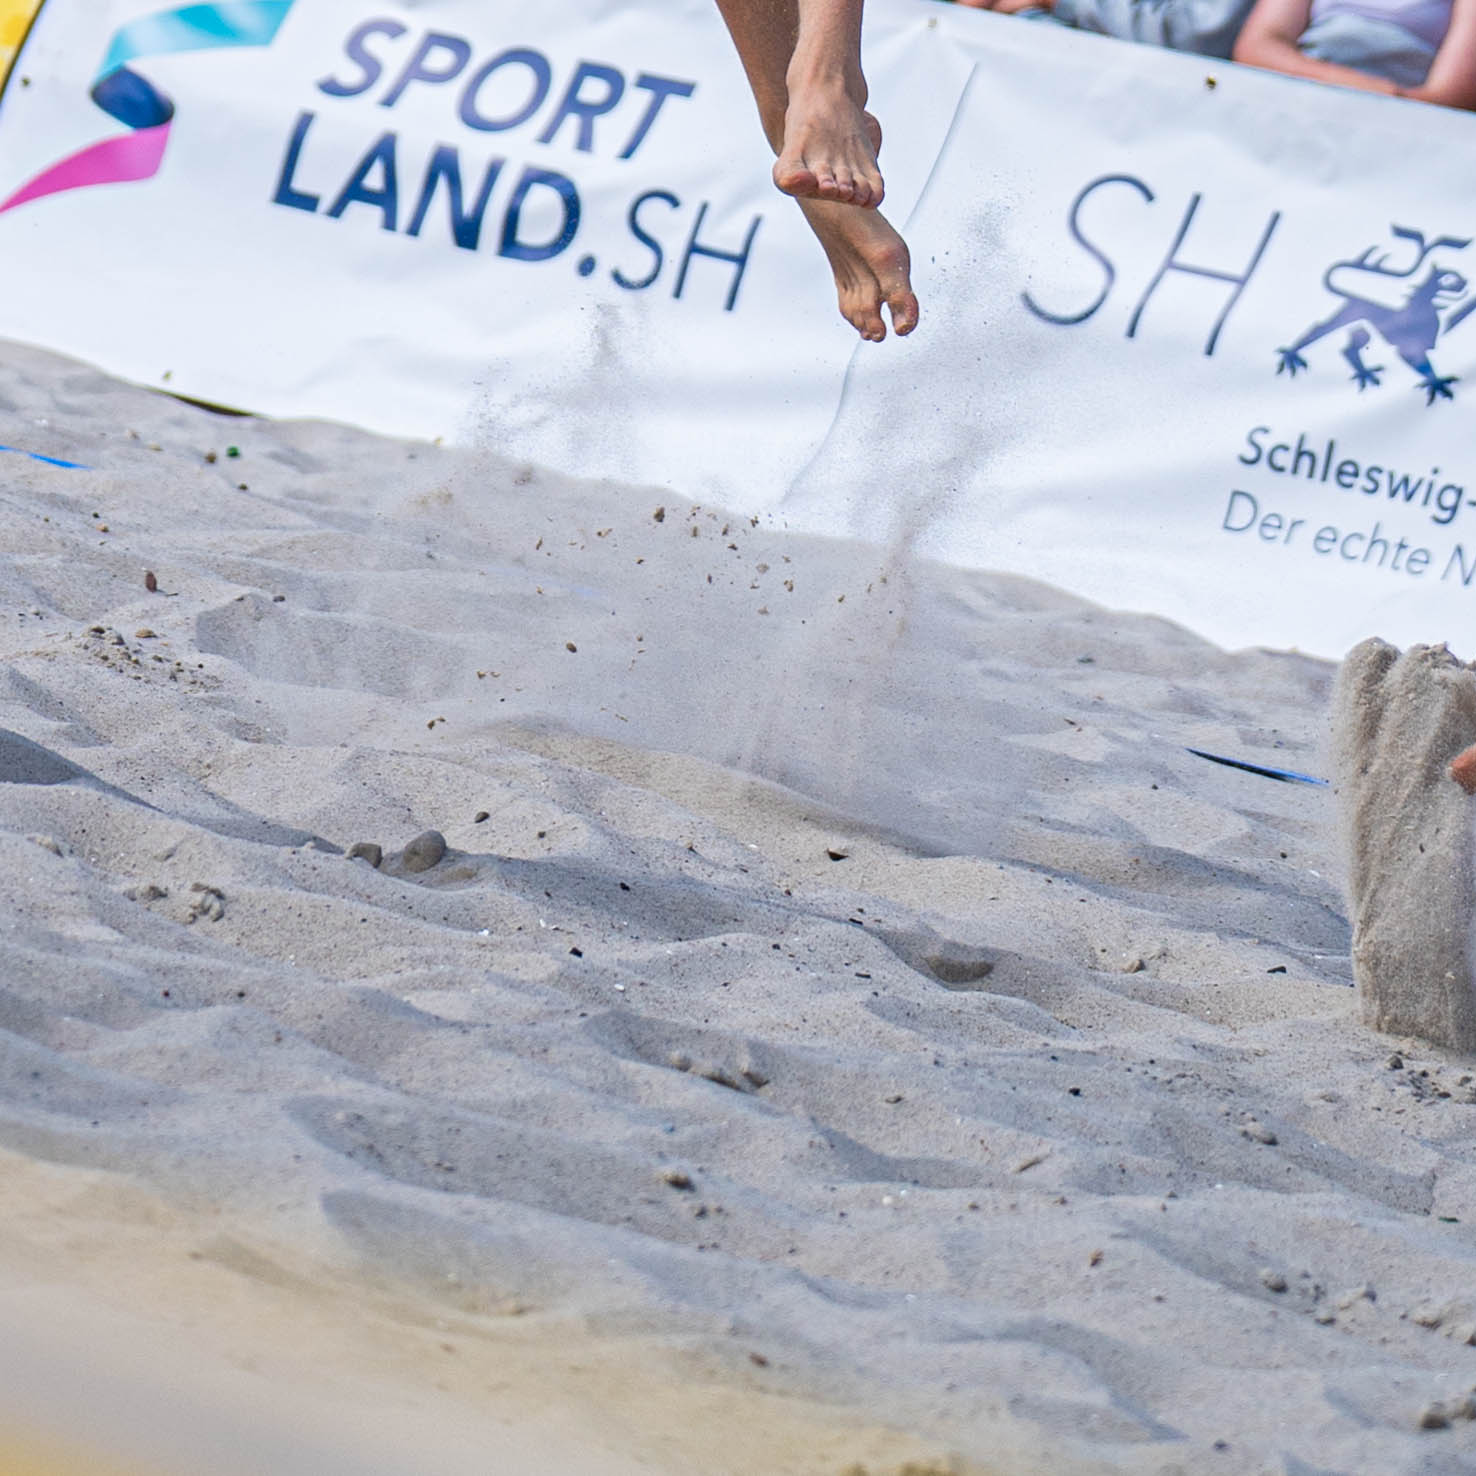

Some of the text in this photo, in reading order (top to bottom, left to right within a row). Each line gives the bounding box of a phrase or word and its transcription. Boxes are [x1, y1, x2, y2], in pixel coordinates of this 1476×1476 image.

[316, 17, 697, 160] SPORT
[271, 110, 764, 313] LAND.SH
[1020, 173, 1282, 356] SH
[1222, 489, 1305, 546] Der
[1313, 519, 1432, 576] echte
